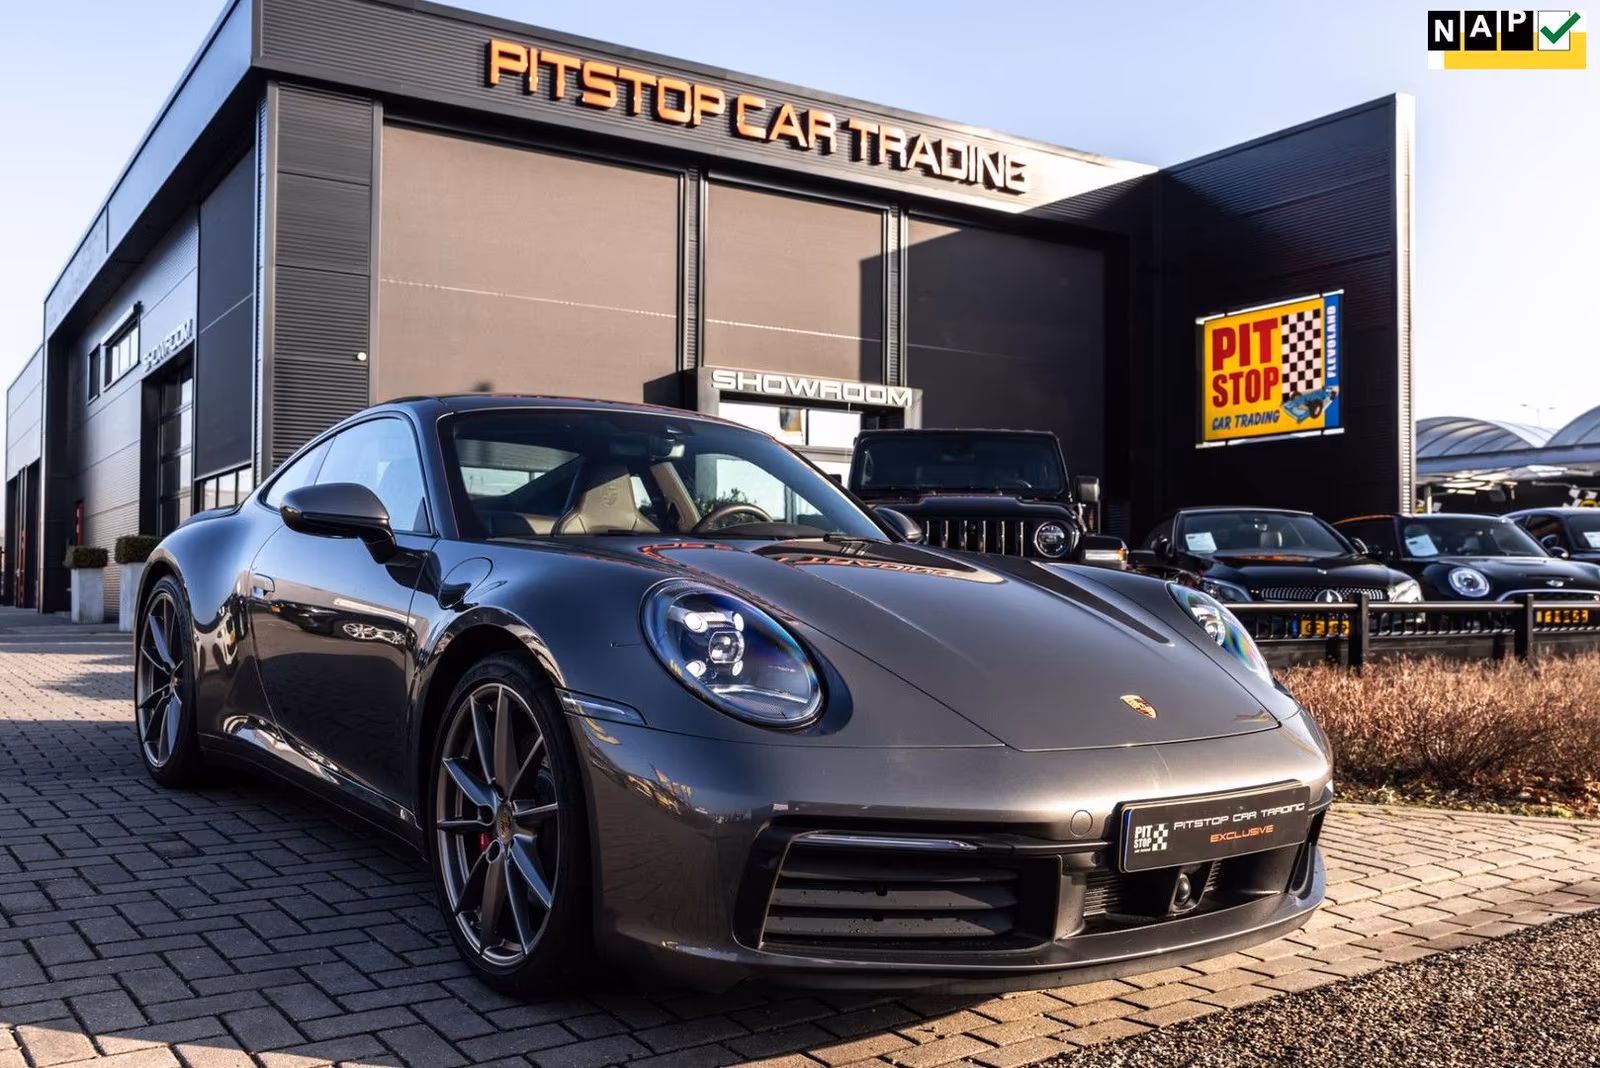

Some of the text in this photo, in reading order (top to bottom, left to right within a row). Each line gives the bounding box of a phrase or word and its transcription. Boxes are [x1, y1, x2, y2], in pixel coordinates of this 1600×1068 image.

[487, 39, 1031, 194] PITSTOP CAR TRADING
[1211, 317, 1279, 372] PIT
[1326, 305, 1337, 379] FLEVOLAND
[712, 369, 913, 407] SHOWROOM
[1211, 366, 1280, 409] STOP
[1211, 409, 1281, 431] CAR TRADING
[1134, 824, 1154, 839] PIT
[1173, 815, 1230, 831] PITSTOP
[1232, 810, 1257, 823] CAR
[1209, 824, 1275, 843] EXCLUSIVE
[1133, 837, 1152, 849] STOP
